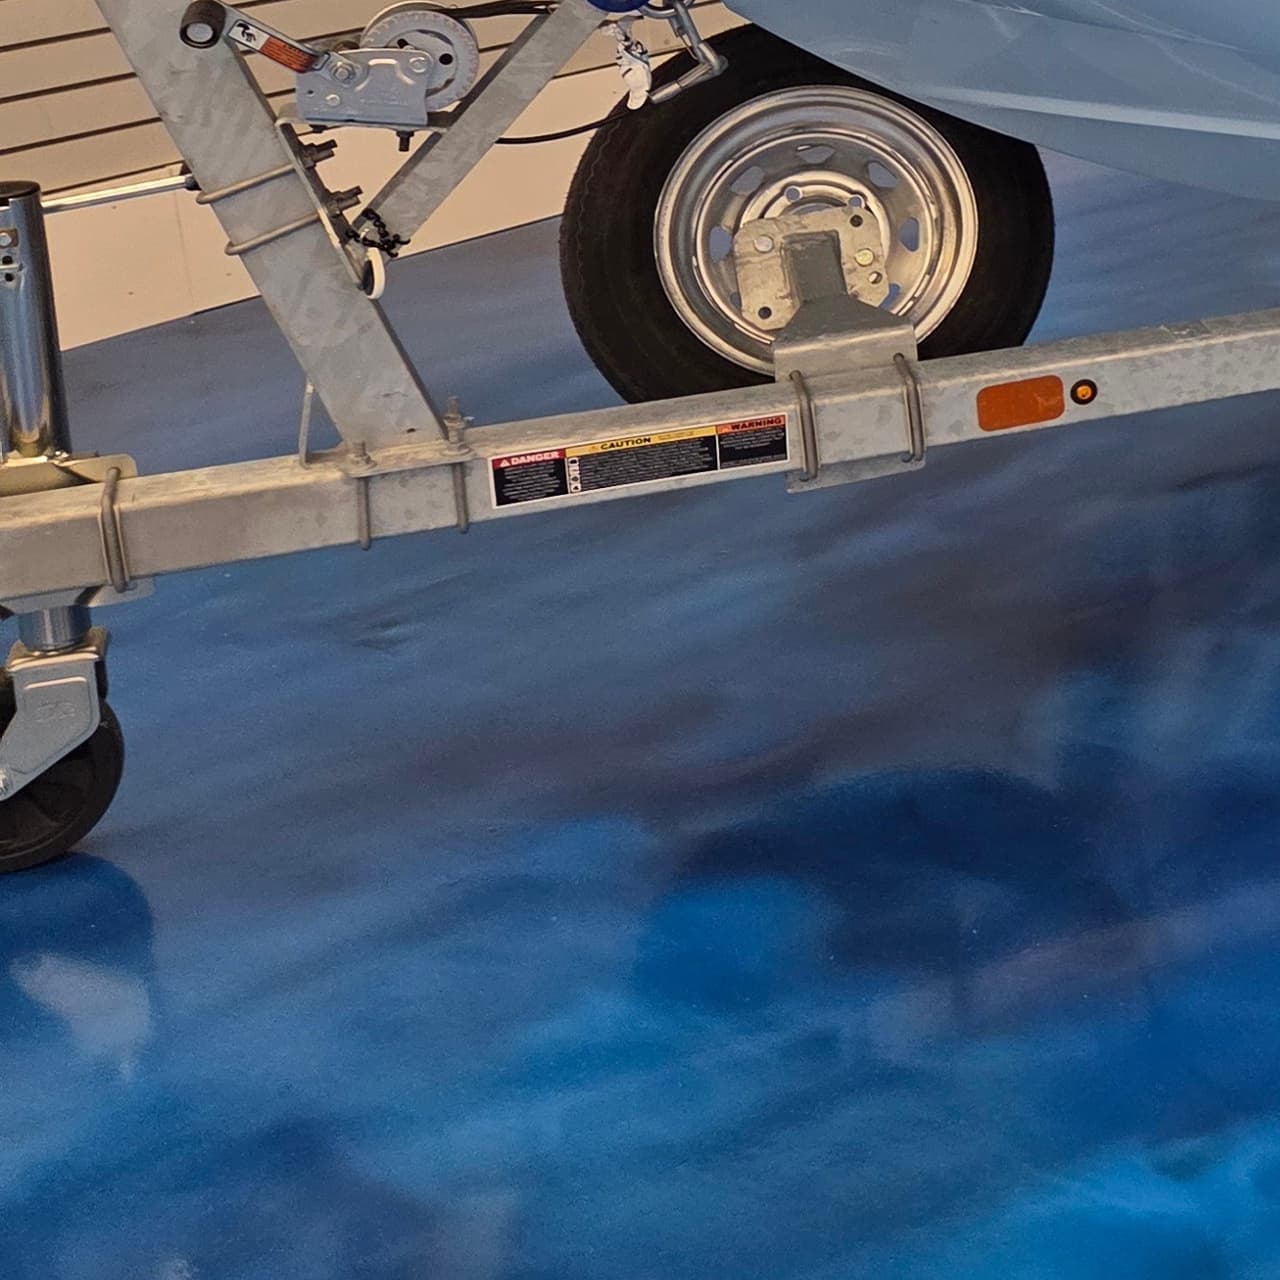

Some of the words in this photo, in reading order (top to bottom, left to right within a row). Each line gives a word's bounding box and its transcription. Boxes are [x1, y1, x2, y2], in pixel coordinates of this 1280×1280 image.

[730, 418, 782, 431] WARNING
[600, 437, 652, 451] CAUTION
[510, 451, 560, 466] DANGER
